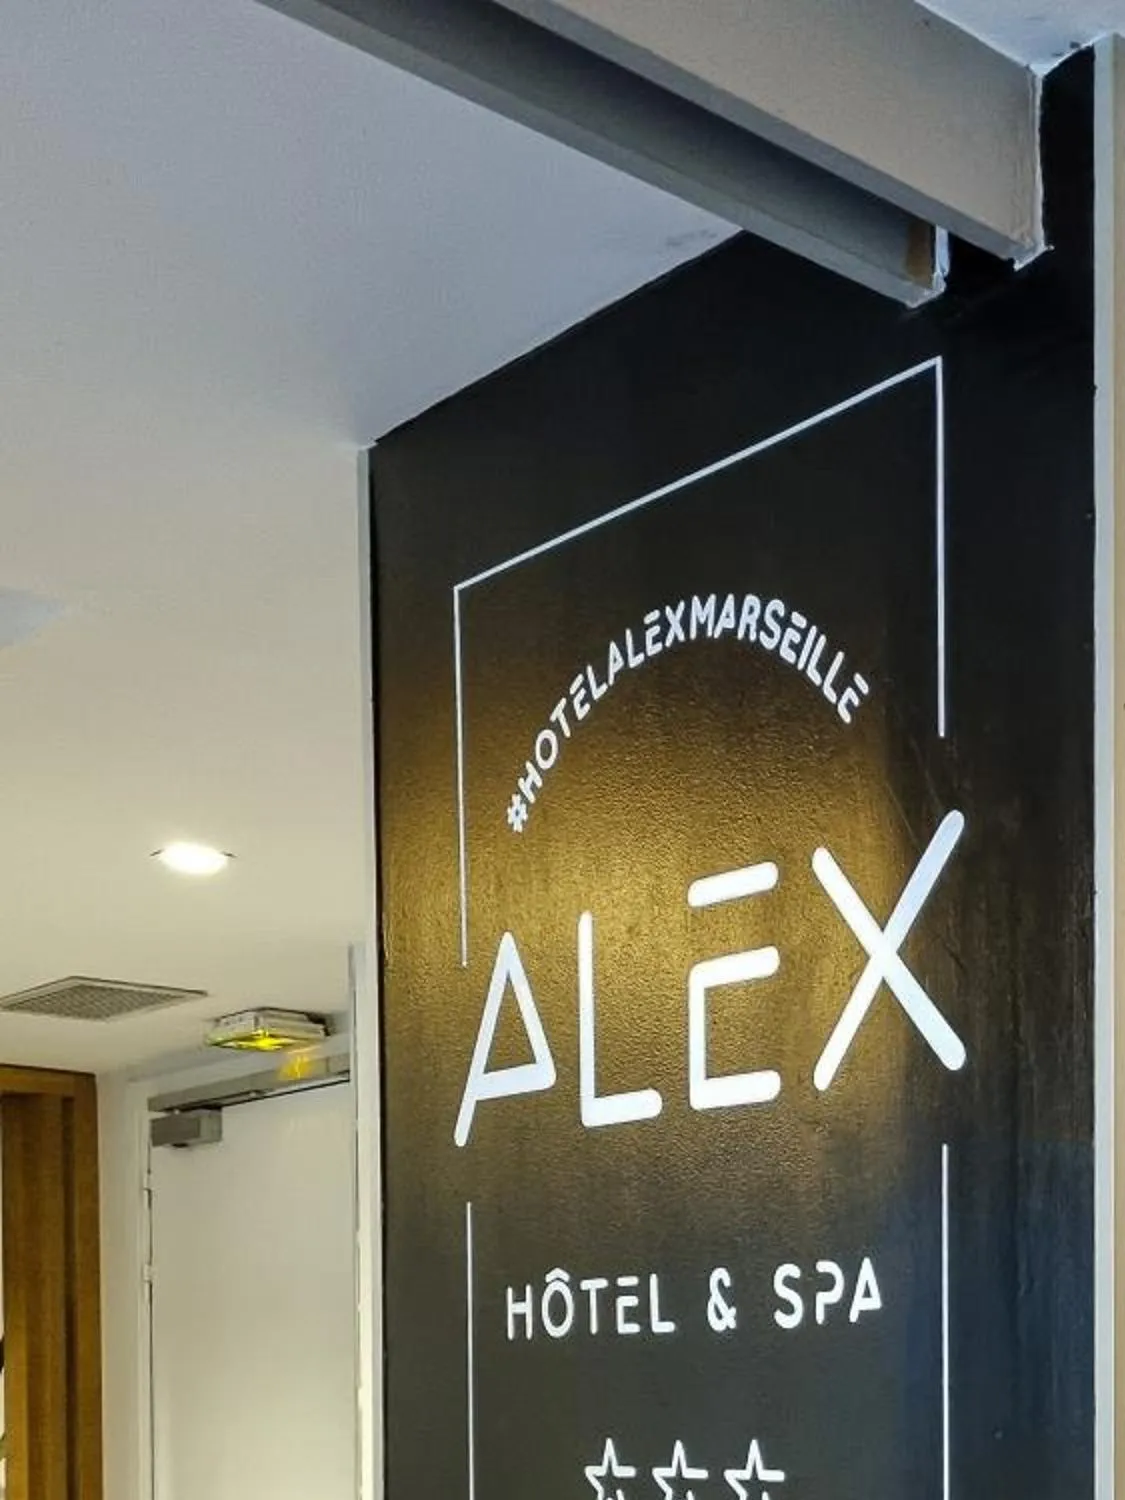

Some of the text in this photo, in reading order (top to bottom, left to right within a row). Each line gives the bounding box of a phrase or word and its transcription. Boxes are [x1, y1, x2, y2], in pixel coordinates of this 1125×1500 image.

[506, 593, 870, 833] #HOTELALEXMARSEILLE
[452, 808, 967, 1148] ALEX
[506, 1256, 883, 1341] HÔTEL & SPA
